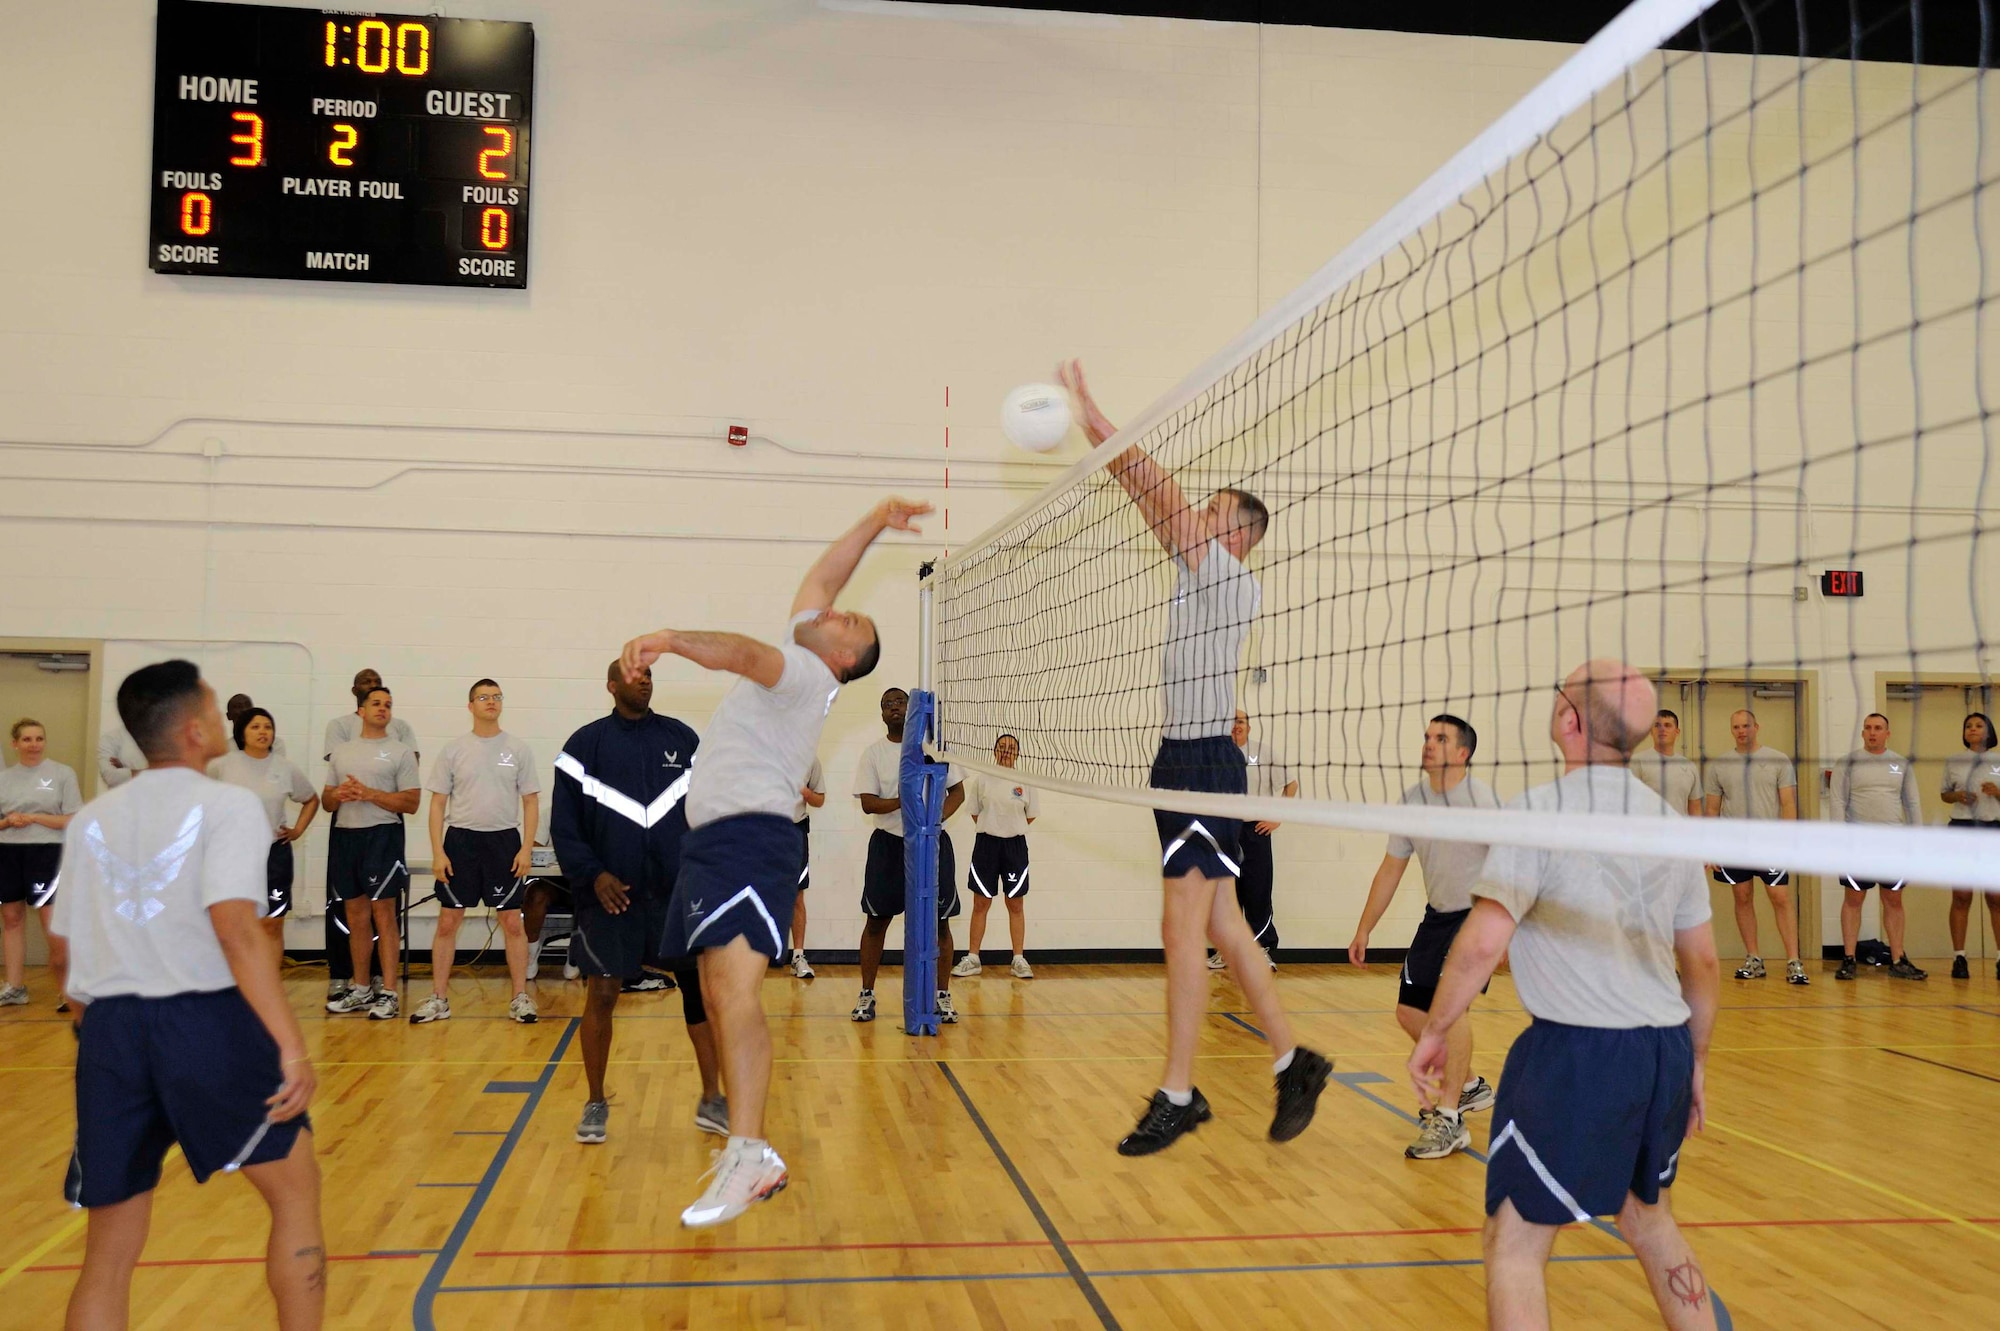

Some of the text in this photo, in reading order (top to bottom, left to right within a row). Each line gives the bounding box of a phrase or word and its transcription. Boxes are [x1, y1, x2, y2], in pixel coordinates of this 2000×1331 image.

[325, 20, 429, 75] 1:00
[179, 75, 258, 104] HOME
[312, 98, 377, 118] PERIOD
[426, 90, 511, 118] GUEST
[230, 111, 264, 167] 3
[329, 124, 357, 166] 2
[478, 126, 511, 179] 2
[162, 171, 222, 190] FOULS
[282, 177, 404, 199] PLAYER FOUL
[463, 186, 519, 205] FOULS
[181, 192, 211, 236] 0
[481, 208, 508, 249] 0
[159, 244, 219, 264] SCORE
[306, 251, 369, 271] MATCH
[459, 258, 515, 277] SCORE
[1831, 572, 1858, 594] EXIT
